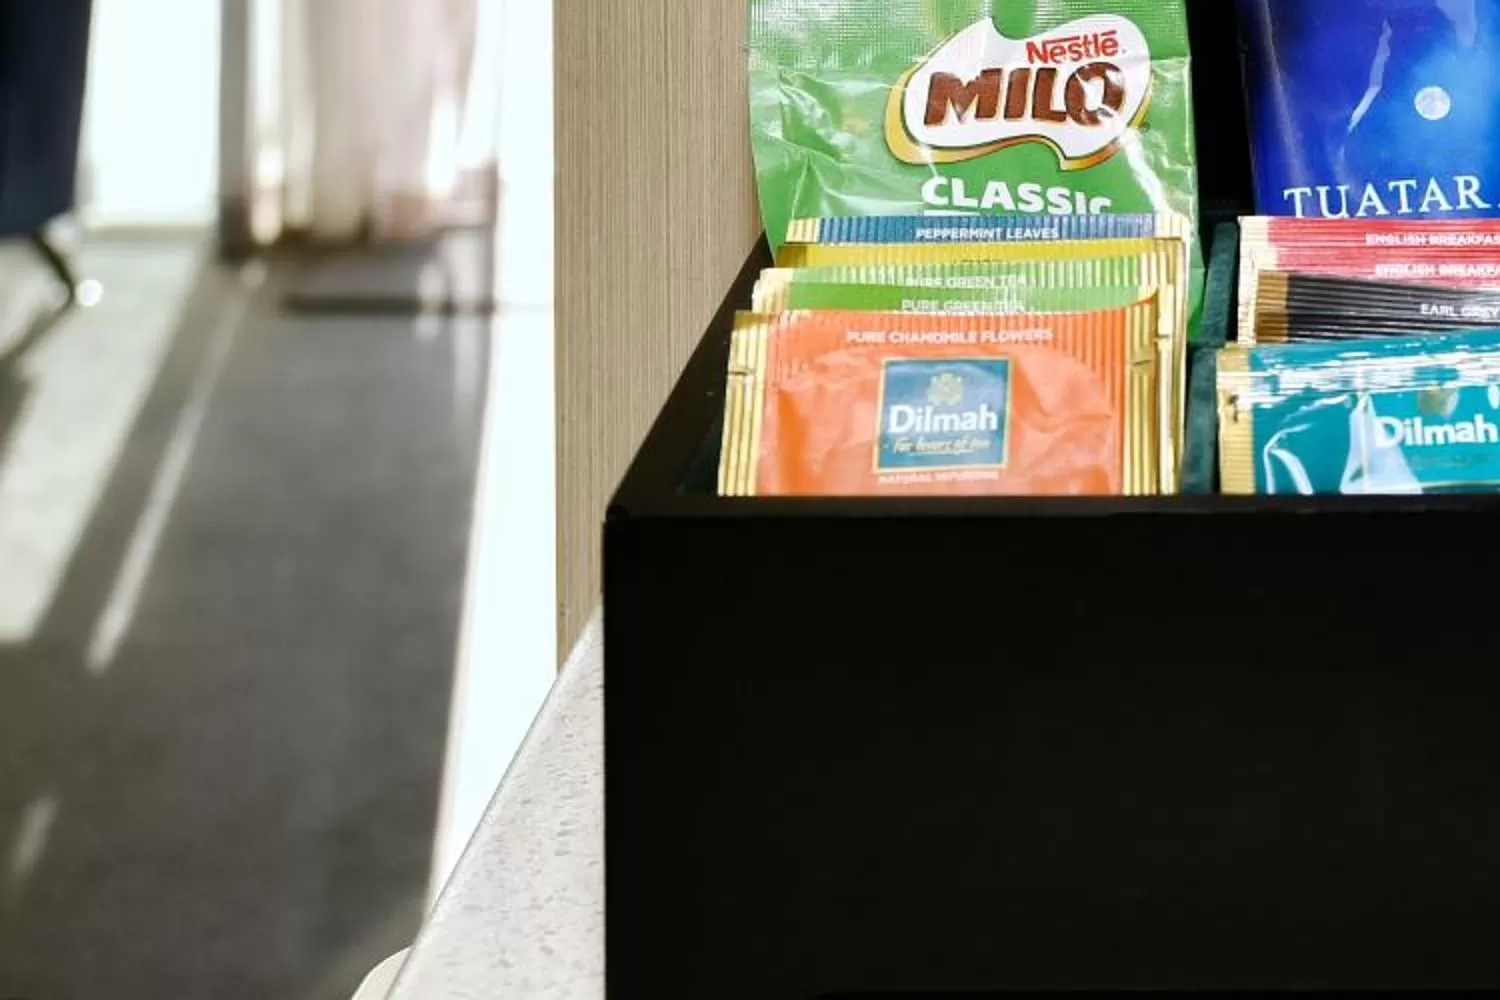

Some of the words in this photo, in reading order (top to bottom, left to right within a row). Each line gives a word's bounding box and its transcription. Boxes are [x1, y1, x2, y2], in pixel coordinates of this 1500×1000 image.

[923, 62, 1126, 126] MILO
[915, 227, 1002, 239] PEPPERMINT
[1006, 227, 1059, 239] LEAVES
[1365, 233, 1426, 246] ENGLISH
[1375, 263, 1435, 276] ENGLISH
[1420, 303, 1458, 317] EARL
[1460, 306, 1500, 319] GREY
[847, 330, 886, 344] PURE
[889, 403, 998, 433] Dilmah
[1373, 412, 1500, 447] Dilmah
